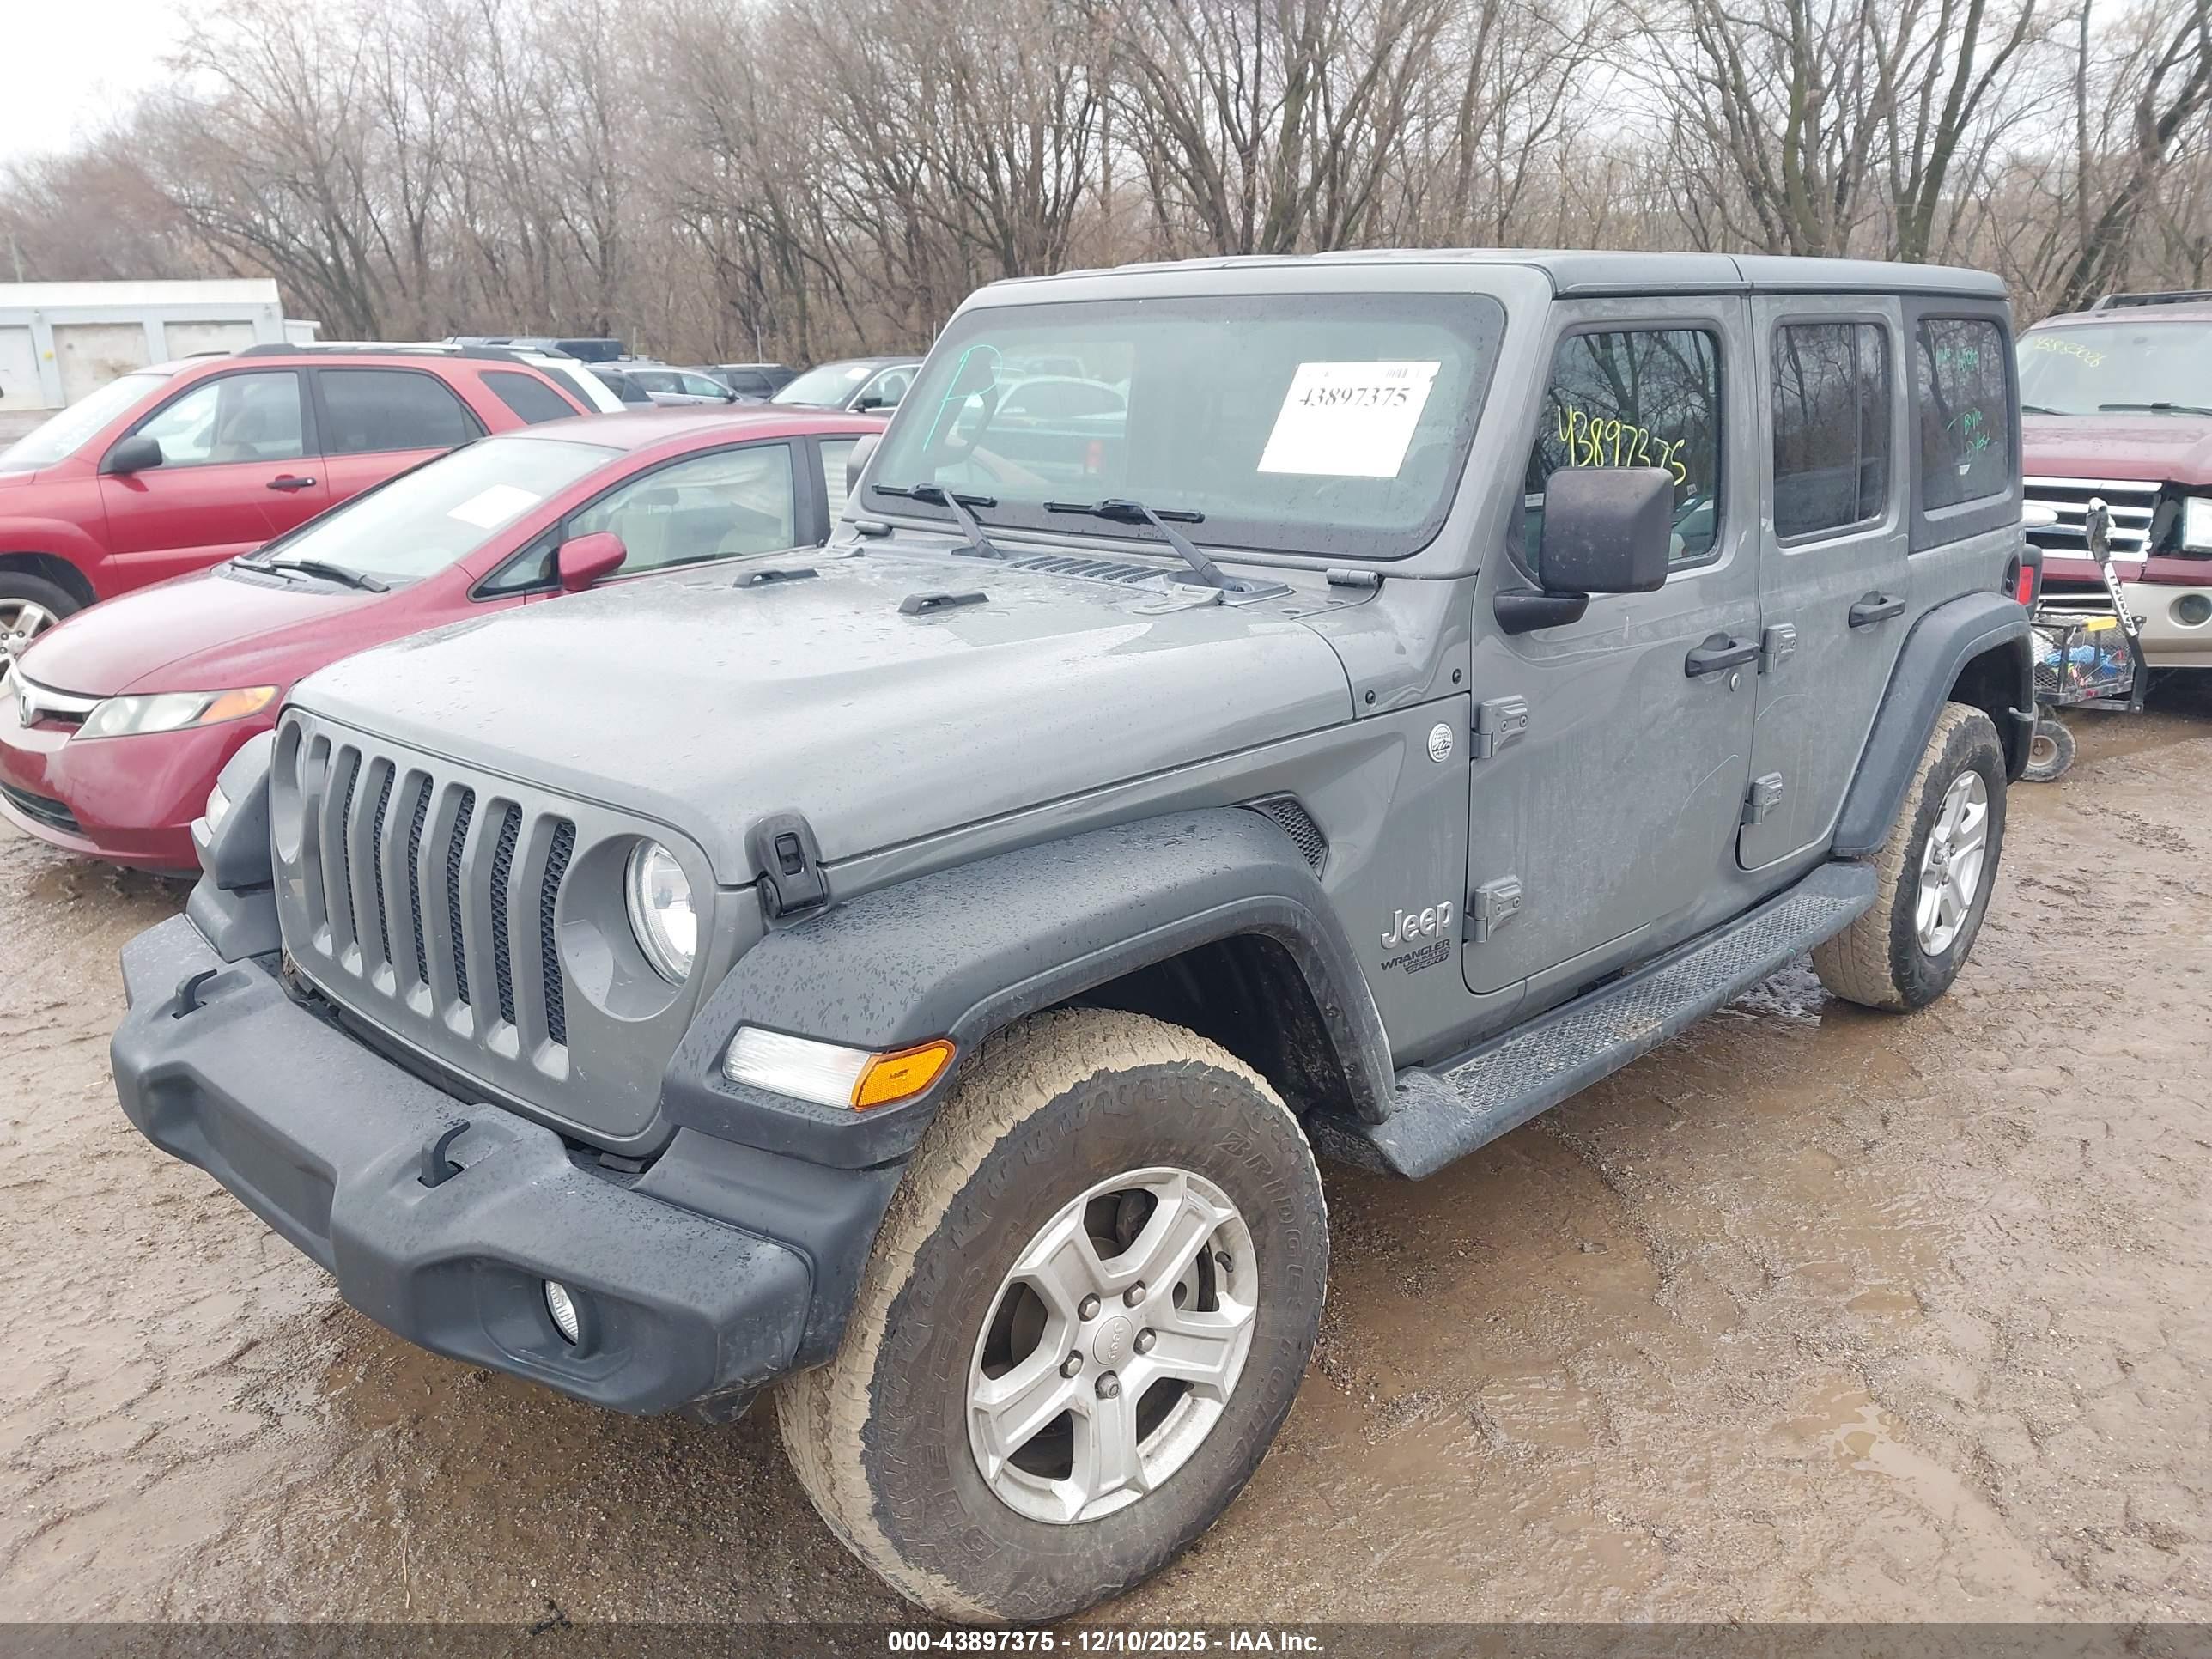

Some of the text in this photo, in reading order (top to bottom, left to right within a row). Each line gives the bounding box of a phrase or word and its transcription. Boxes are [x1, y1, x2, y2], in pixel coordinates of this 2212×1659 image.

[1299, 387, 1410, 406] 43897375
[1558, 404, 1686, 486] 43897375
[1381, 900, 1453, 949] Jeep
[1381, 939, 1450, 970] WRANGLER
[1107, 1322, 1124, 1360] Jeep
